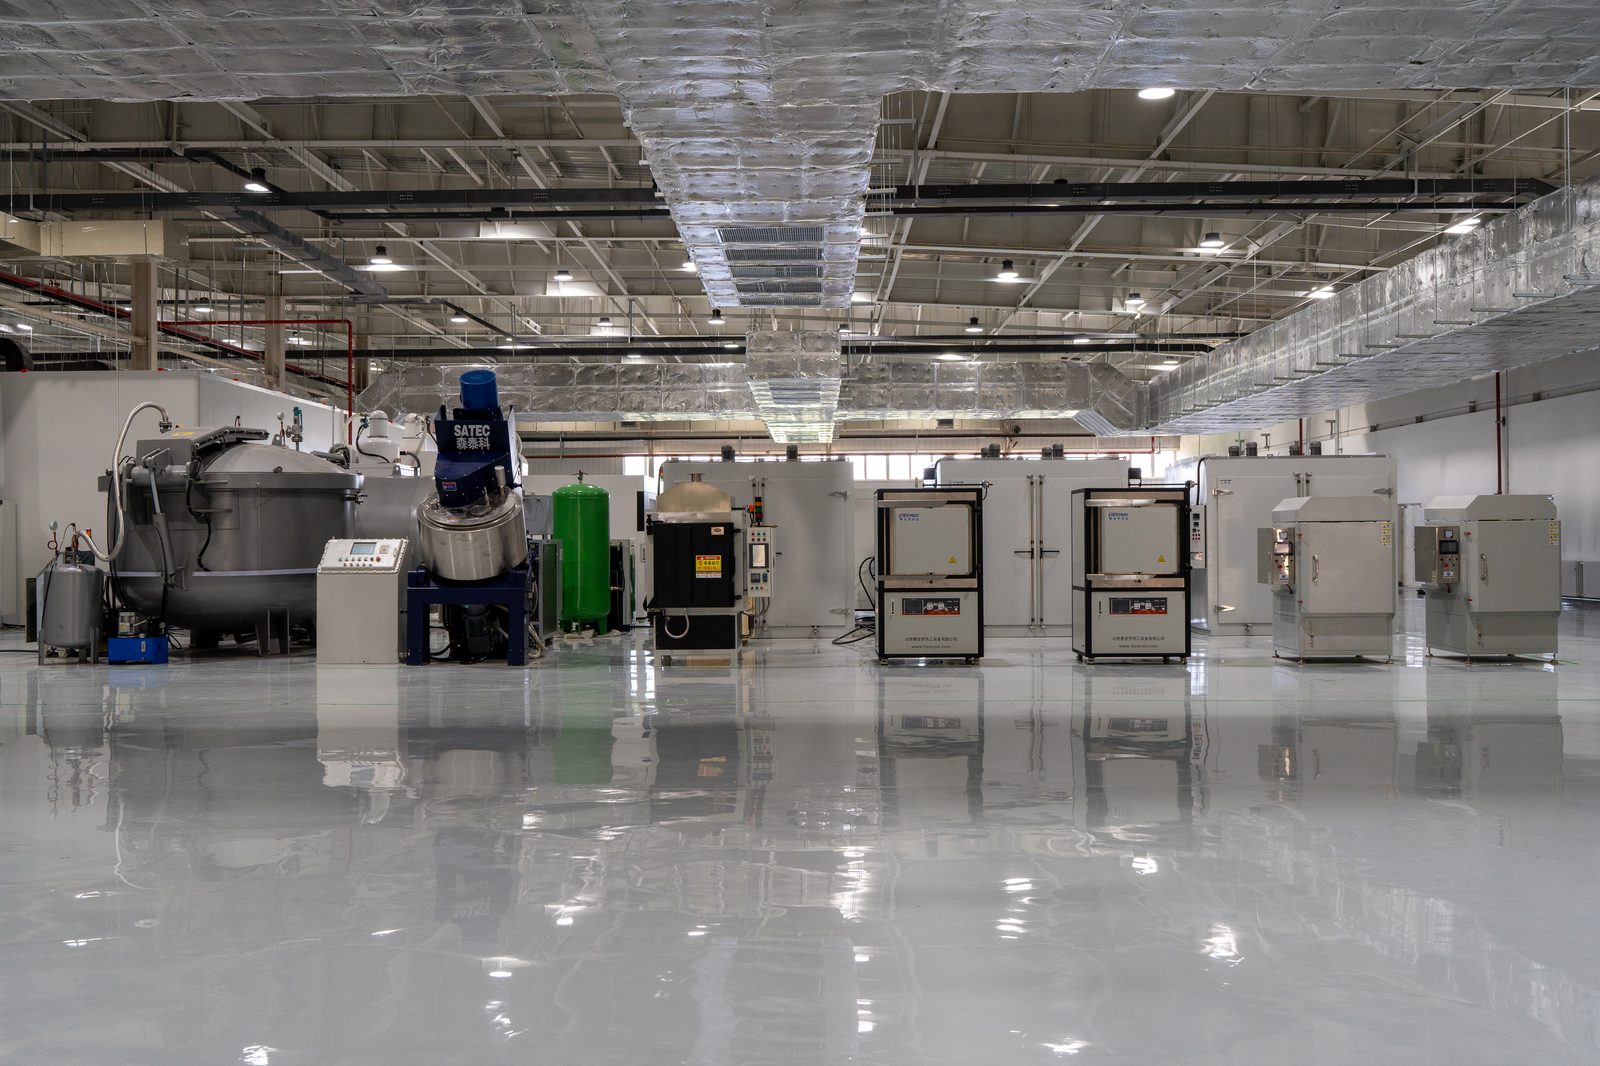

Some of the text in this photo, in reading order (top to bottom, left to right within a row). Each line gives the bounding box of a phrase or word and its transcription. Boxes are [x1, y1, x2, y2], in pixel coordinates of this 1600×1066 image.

[453, 424, 491, 437] SATEC
[456, 437, 490, 450] 森泰科
